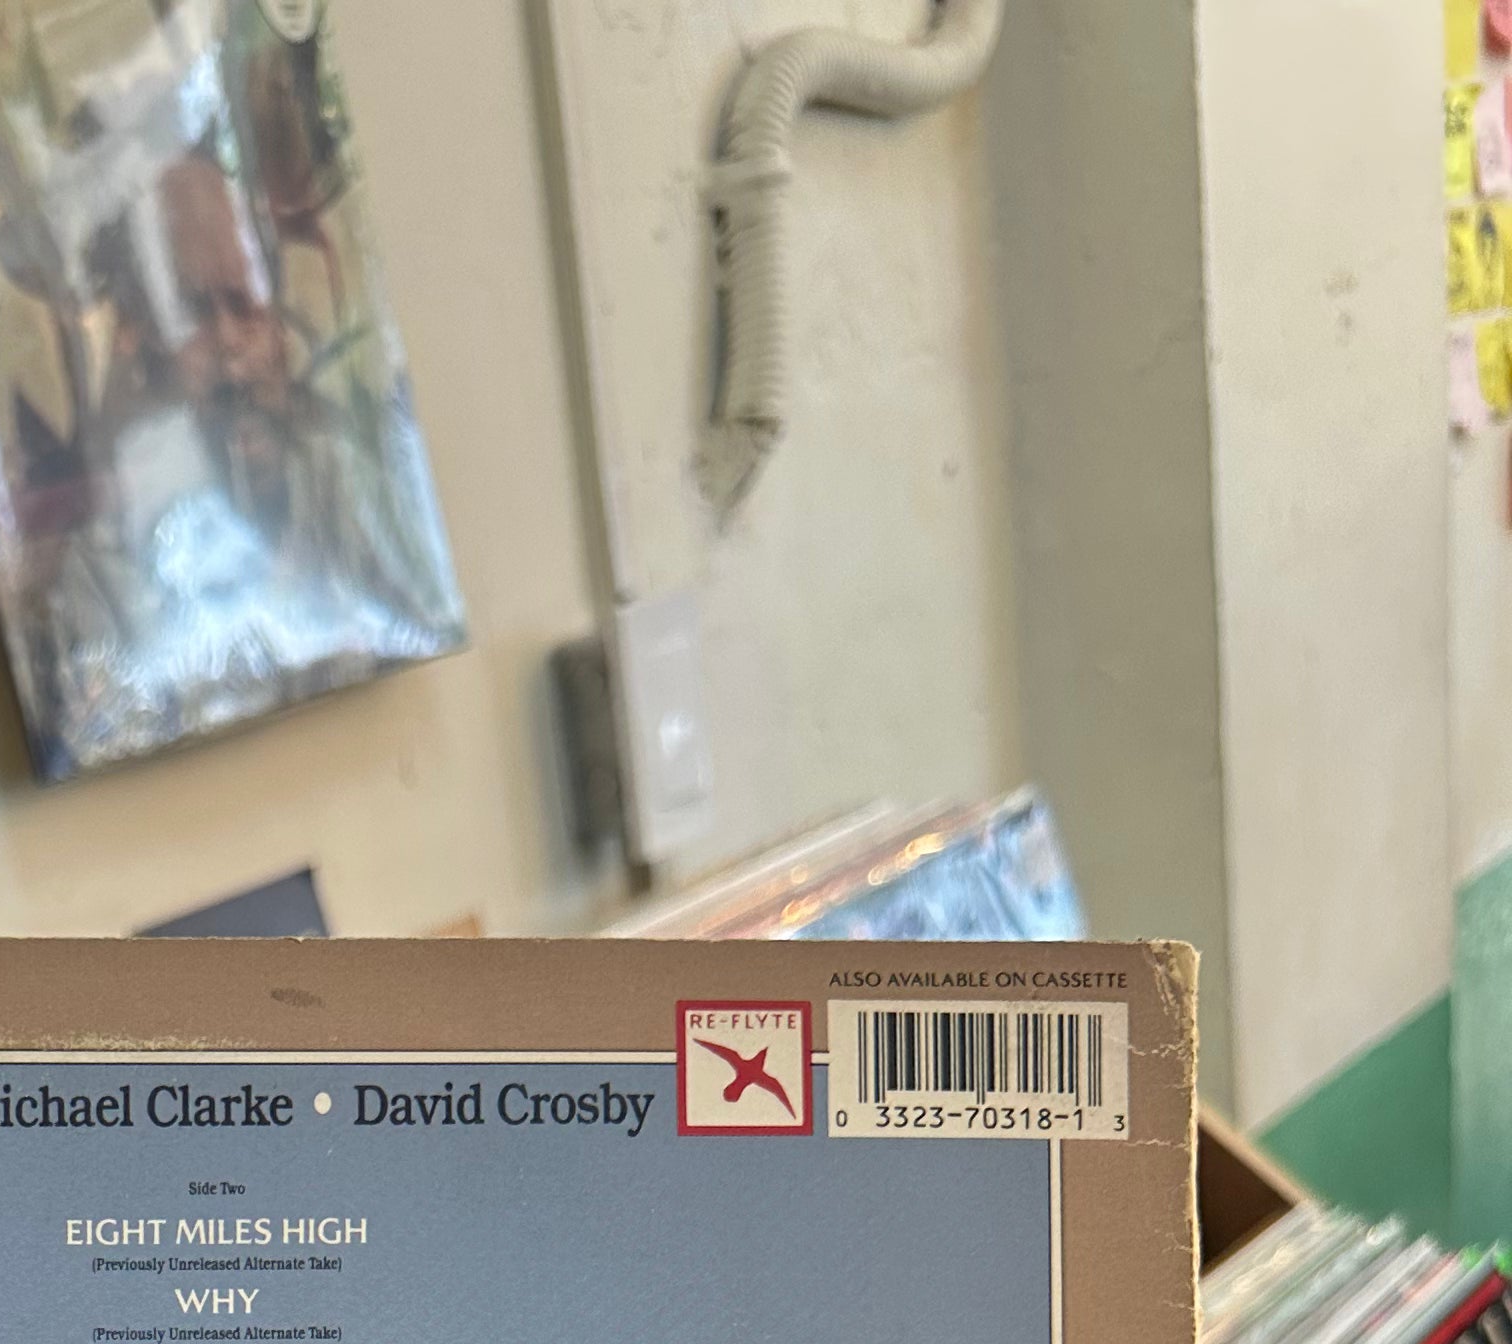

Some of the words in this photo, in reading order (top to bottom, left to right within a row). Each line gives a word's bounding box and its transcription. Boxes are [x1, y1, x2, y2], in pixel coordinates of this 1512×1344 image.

[829, 971, 882, 988] ALSO
[887, 971, 990, 988] AVAILABLE
[994, 971, 1027, 988] ON
[1031, 971, 1128, 989] CASSETTE
[688, 1012, 798, 1032] RE-FLYTE
[146, 1083, 293, 1128] Clarke
[353, 1081, 485, 1126] David
[497, 1081, 656, 1138] Crosby
[835, 1109, 848, 1128] 0
[875, 1103, 1083, 1131] 3323-70318-1
[1113, 1114, 1125, 1132] 3
[188, 1181, 217, 1196] Side
[219, 1181, 246, 1196] Two
[66, 1218, 167, 1246] EIGHT
[175, 1217, 272, 1245] MILES
[282, 1217, 367, 1245] HIGH
[92, 1257, 166, 1275] (Previously
[168, 1256, 241, 1271] Unreleased
[243, 1256, 306, 1271] Alternate
[307, 1255, 342, 1273] Take)
[174, 1288, 260, 1314] WHY
[92, 1326, 166, 1344] (Previously
[168, 1326, 241, 1341] Unreleased
[243, 1326, 306, 1340] Alternate
[307, 1325, 342, 1342] Take)
